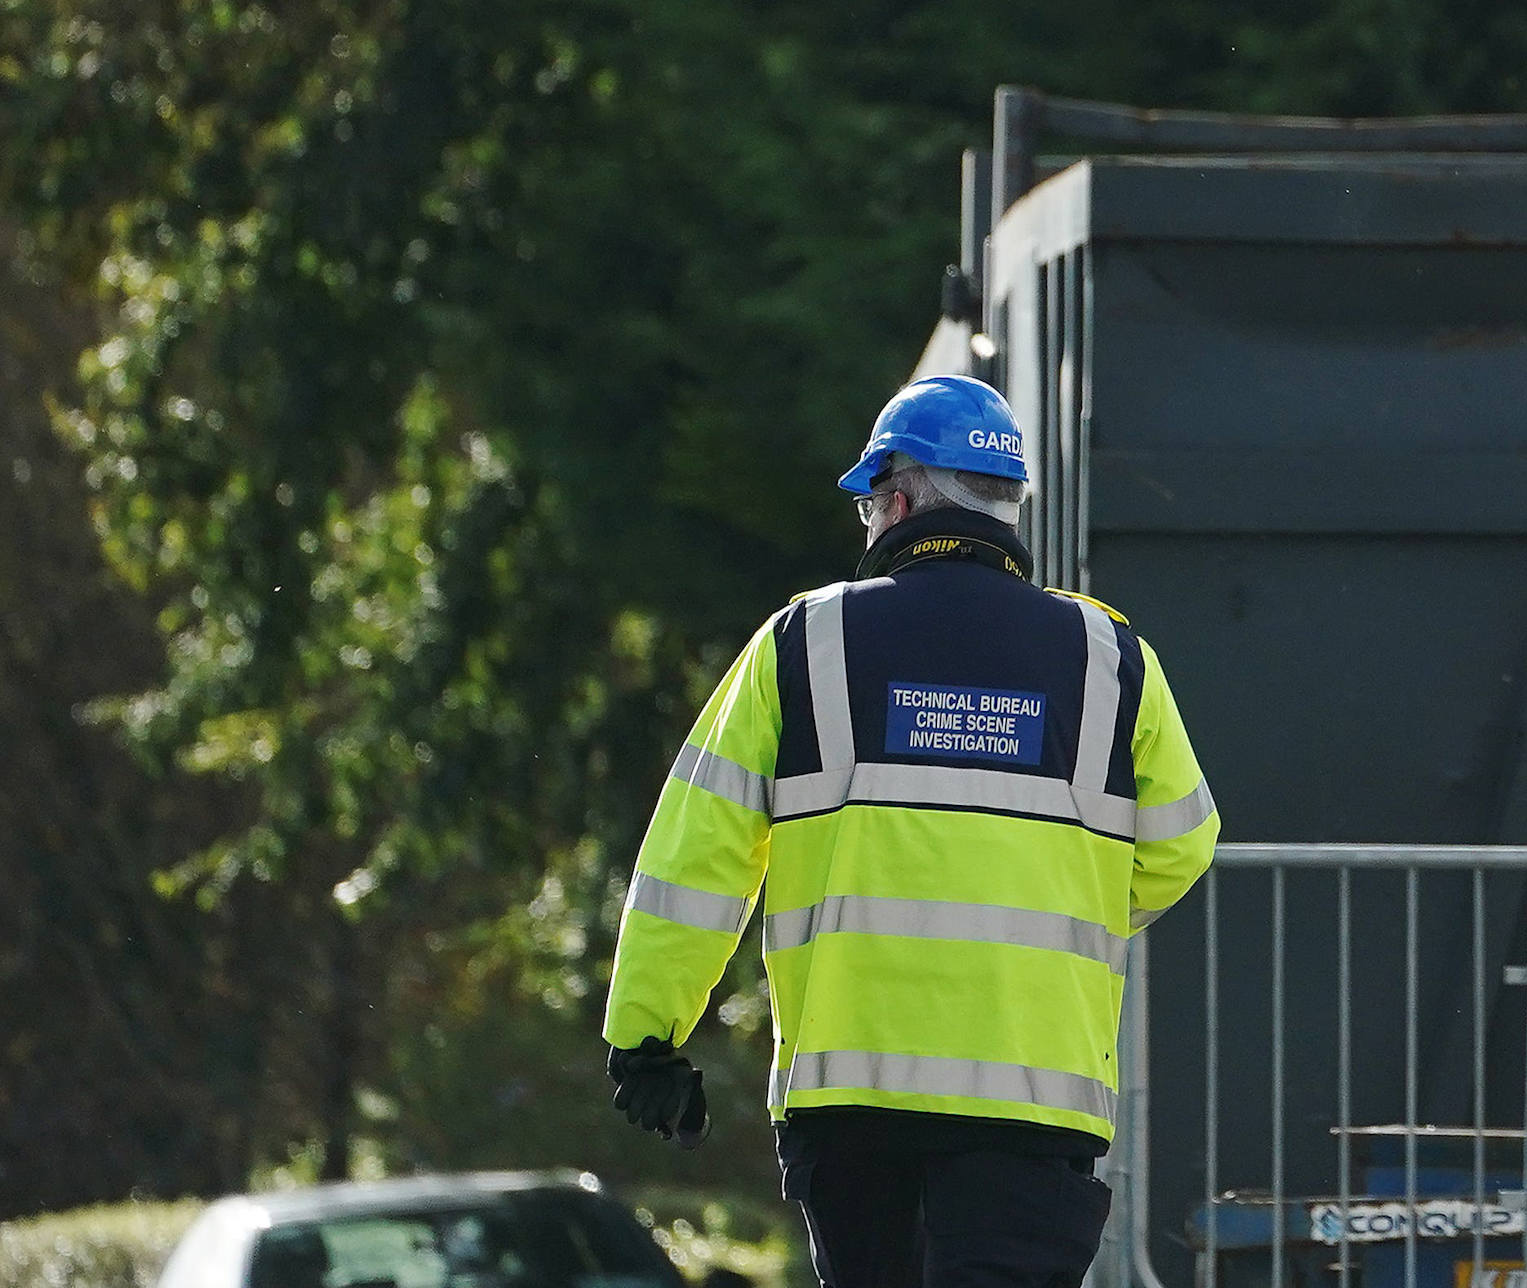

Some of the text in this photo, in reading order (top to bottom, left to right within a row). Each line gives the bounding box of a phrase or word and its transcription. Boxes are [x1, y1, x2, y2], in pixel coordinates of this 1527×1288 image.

[912, 538, 960, 556] Nikon
[893, 688, 1041, 717] TECHNICAL BUREAU
[916, 710, 1016, 735] CRIME SCENE
[909, 730, 1019, 756] INVESTIGATION
